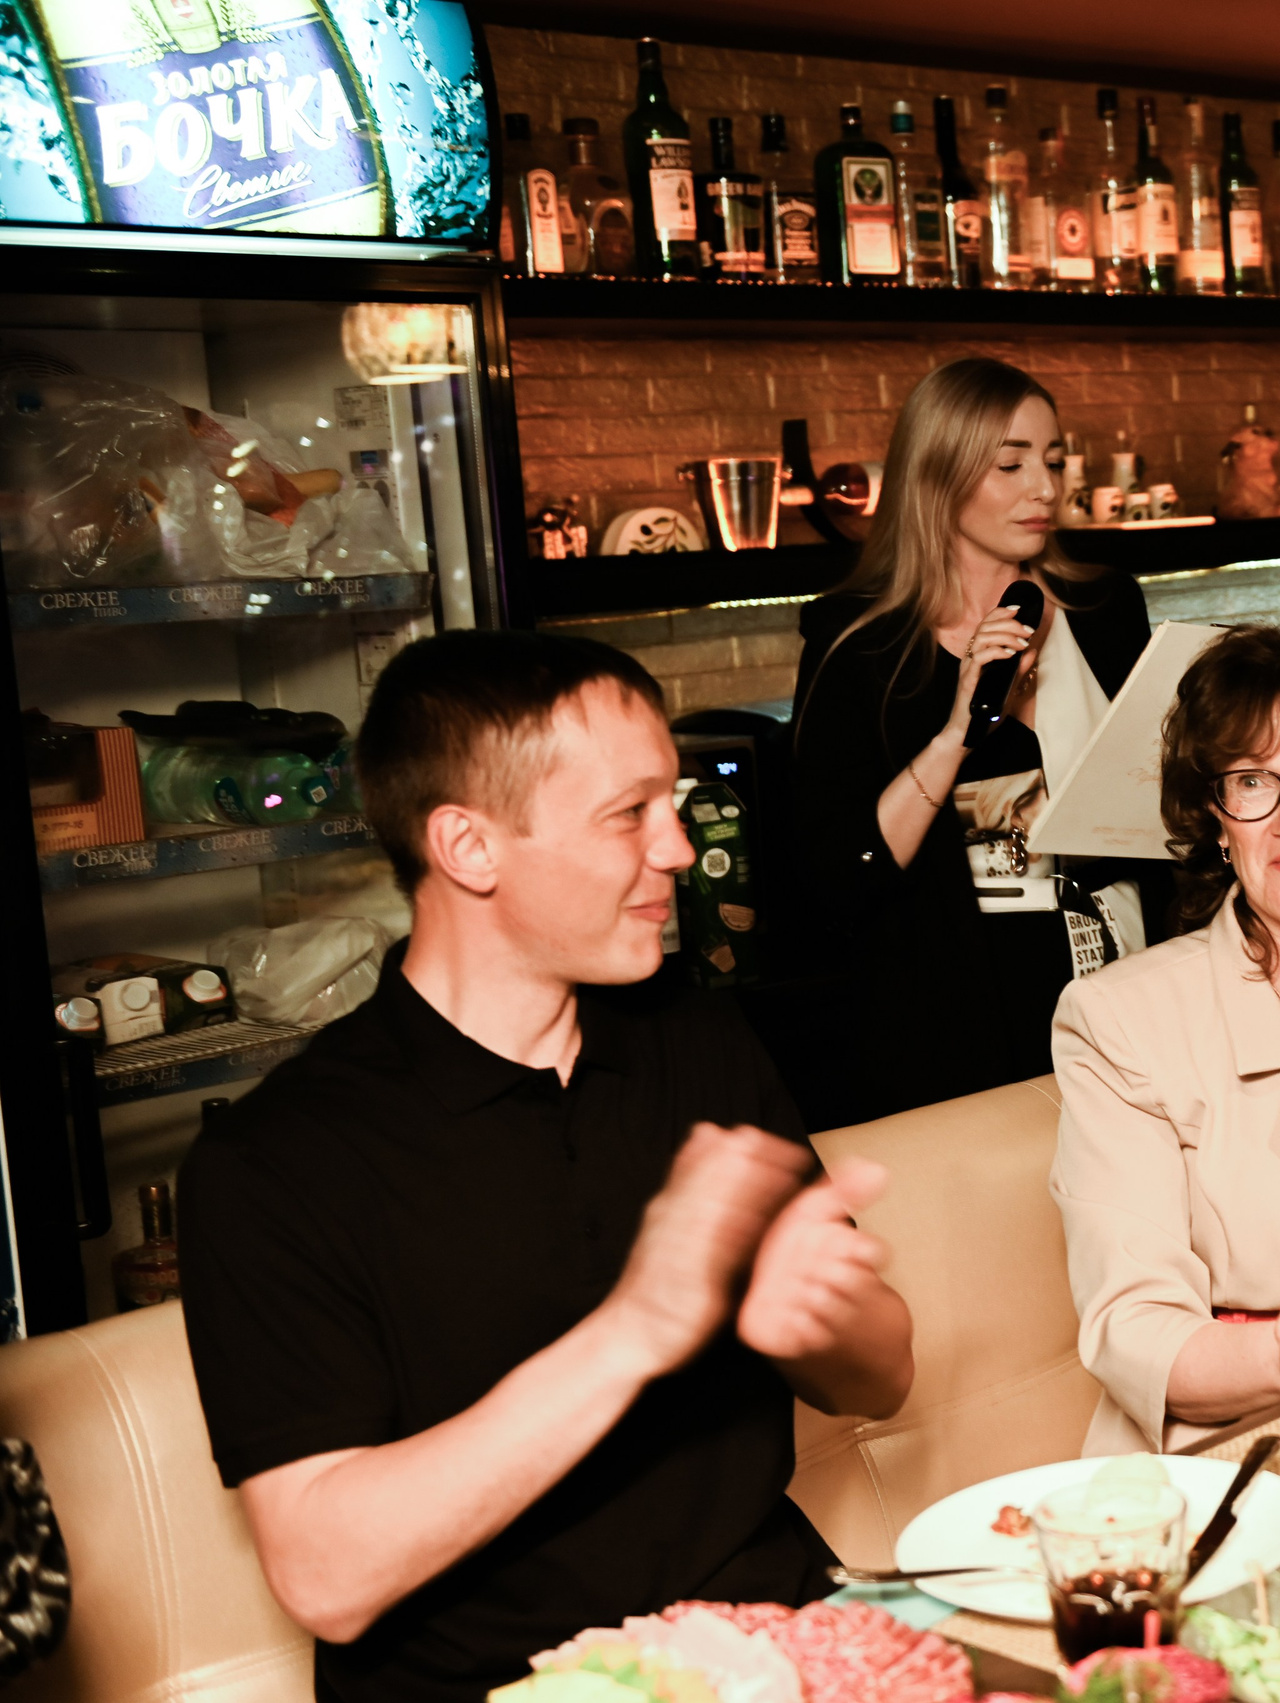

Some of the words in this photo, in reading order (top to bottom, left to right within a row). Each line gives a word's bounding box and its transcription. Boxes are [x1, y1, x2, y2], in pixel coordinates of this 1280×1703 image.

[148, 51, 287, 105] ЗОЛОТАЯ
[95, 68, 361, 187] БОЧКА
[168, 585, 243, 604] СВЕЖЕЕ
[295, 579, 365, 597] СВЕЖЕЕ
[39, 590, 120, 610] СВЕЖЕЕ
[93, 606, 127, 618] ПИВО
[322, 817, 373, 836] СВЕЖ
[199, 829, 272, 852] СВЕЖЕЕ
[73, 845, 150, 868] СВЕЖЕЕ
[1072, 929, 1103, 947] UNIT
[1076, 947, 1104, 965] STAT
